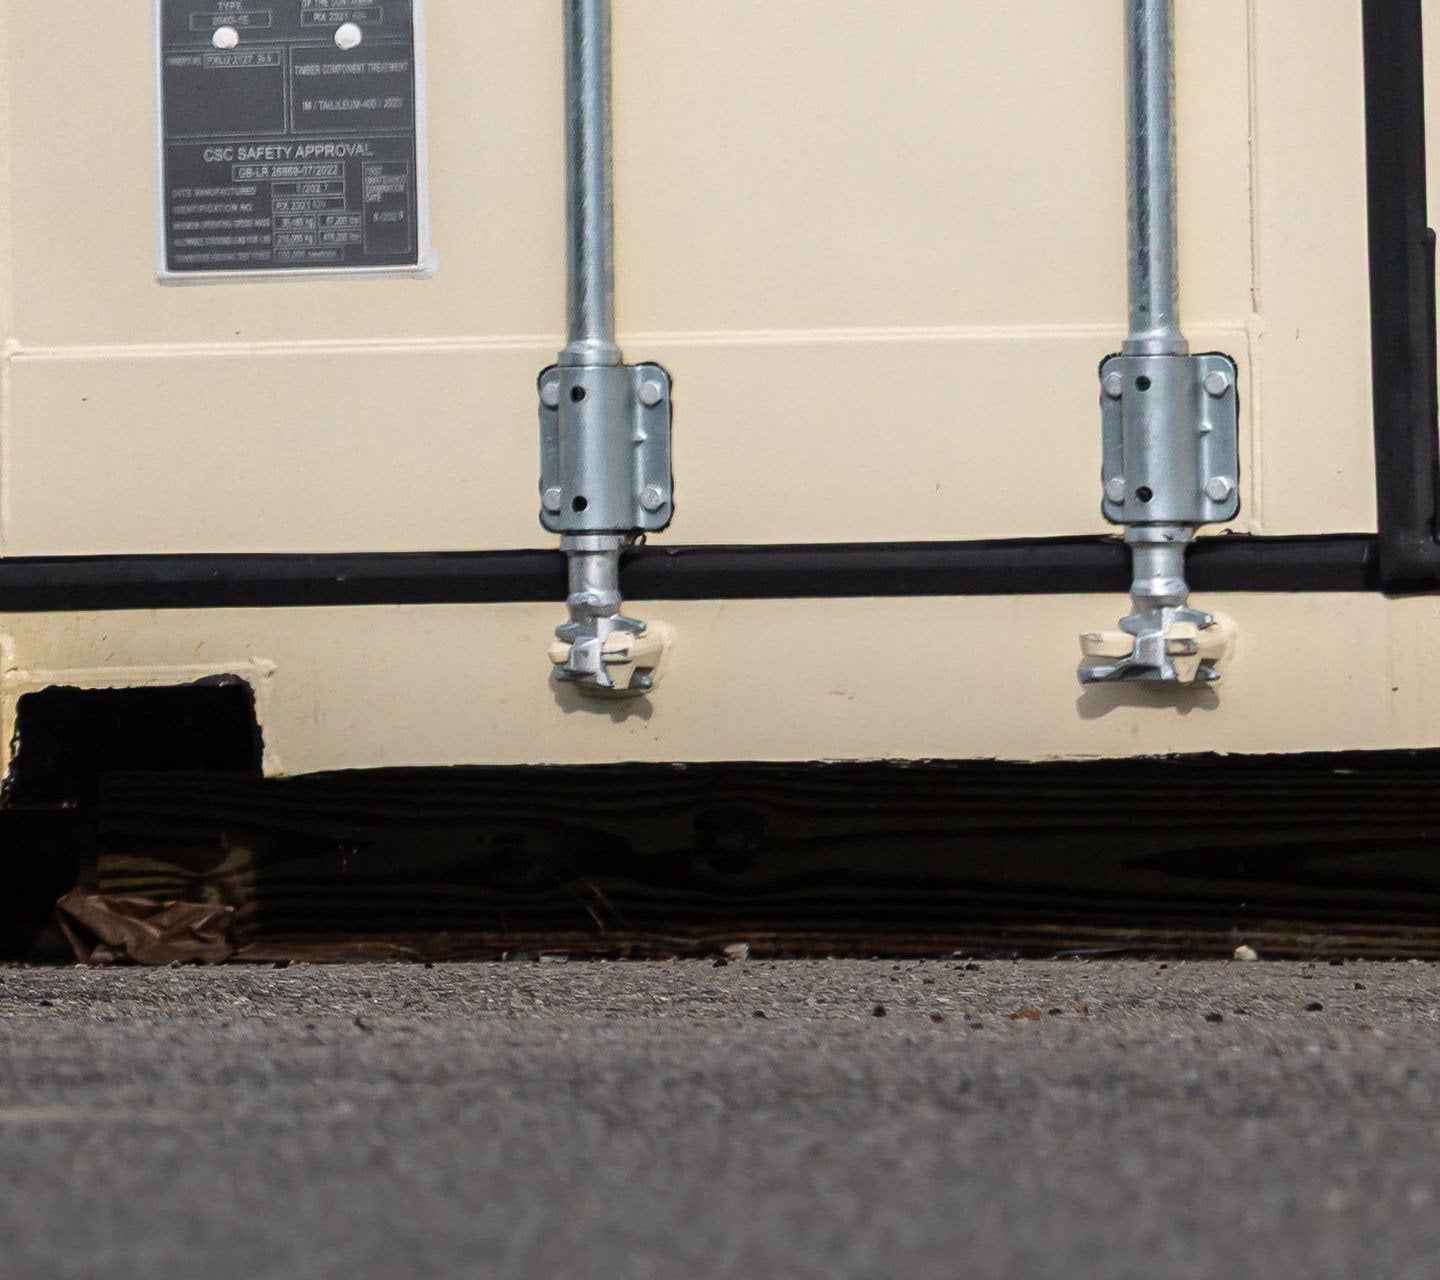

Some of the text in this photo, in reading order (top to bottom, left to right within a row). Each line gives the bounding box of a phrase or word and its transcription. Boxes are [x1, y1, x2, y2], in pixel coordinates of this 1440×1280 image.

[217, 1, 243, 11] TYPE
[203, 142, 374, 161] CSC SAFETY APPROVAL
